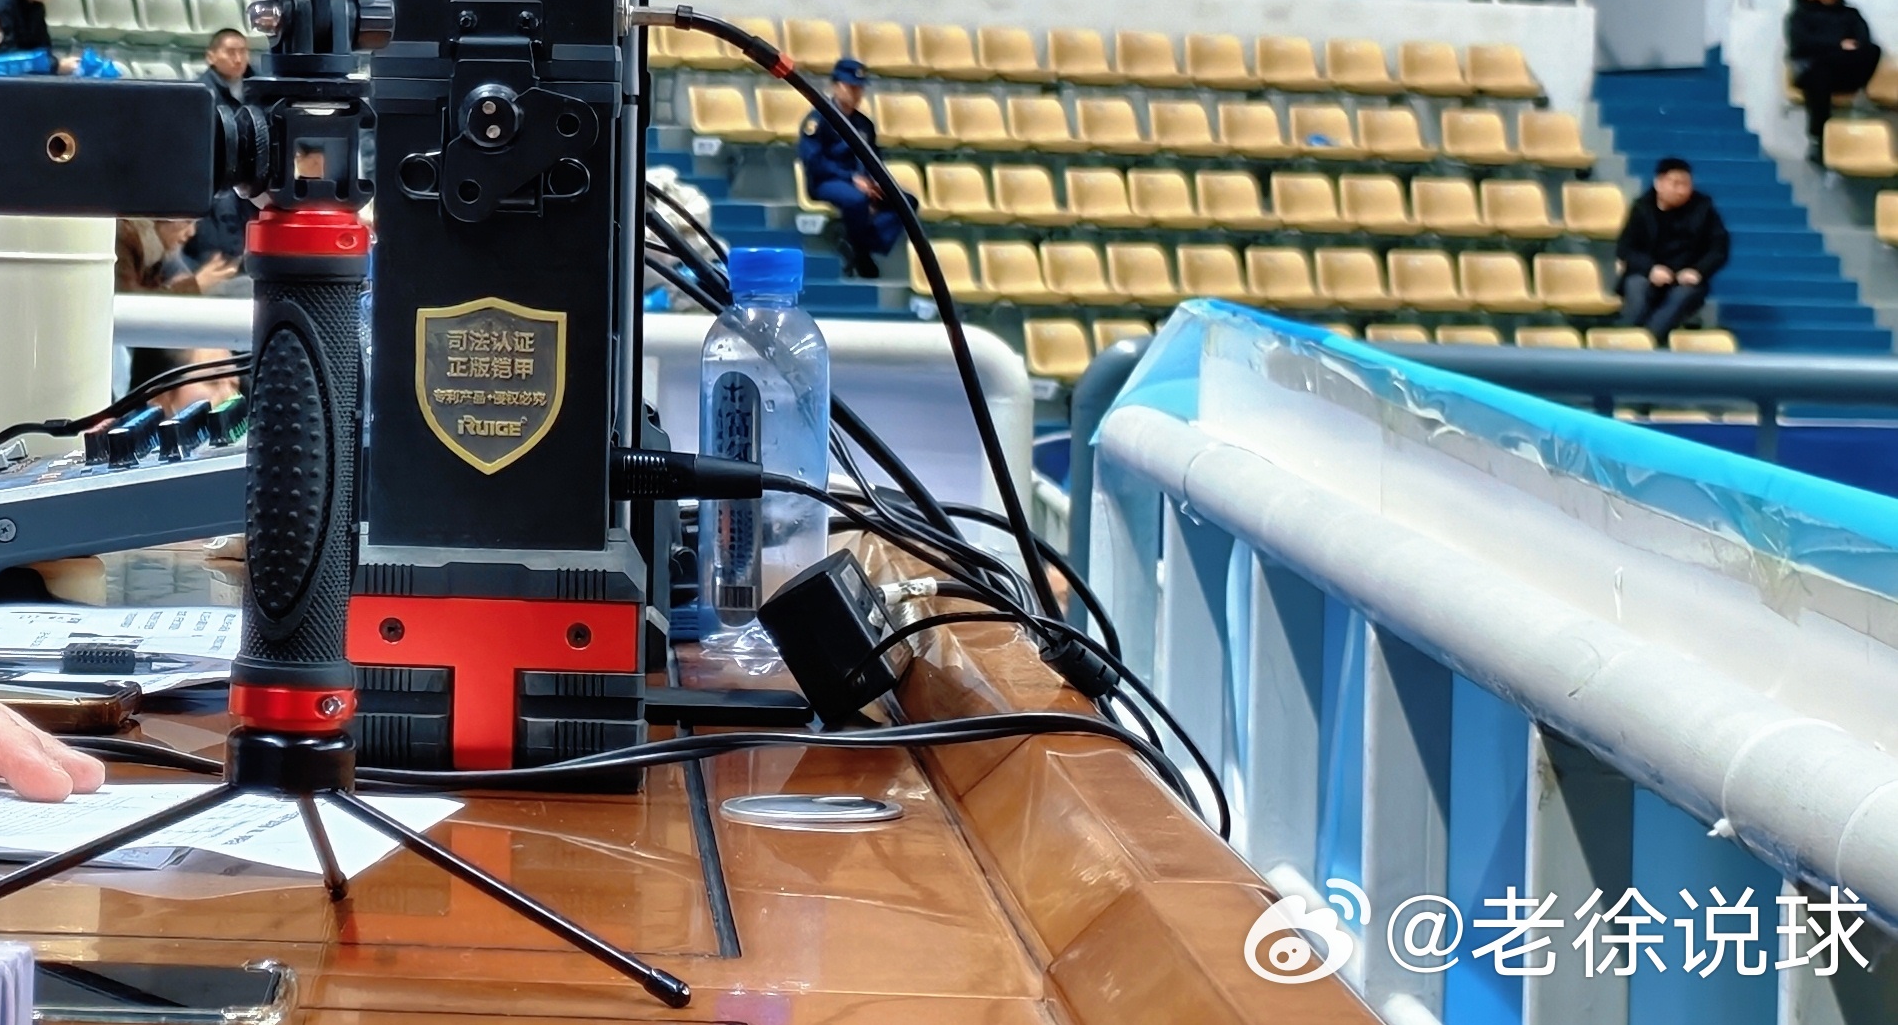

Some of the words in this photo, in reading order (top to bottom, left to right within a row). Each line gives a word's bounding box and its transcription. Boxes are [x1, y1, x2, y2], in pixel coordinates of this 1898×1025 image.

[446, 329, 535, 353] 司法认证
[446, 356, 535, 380] 正版铠甲
